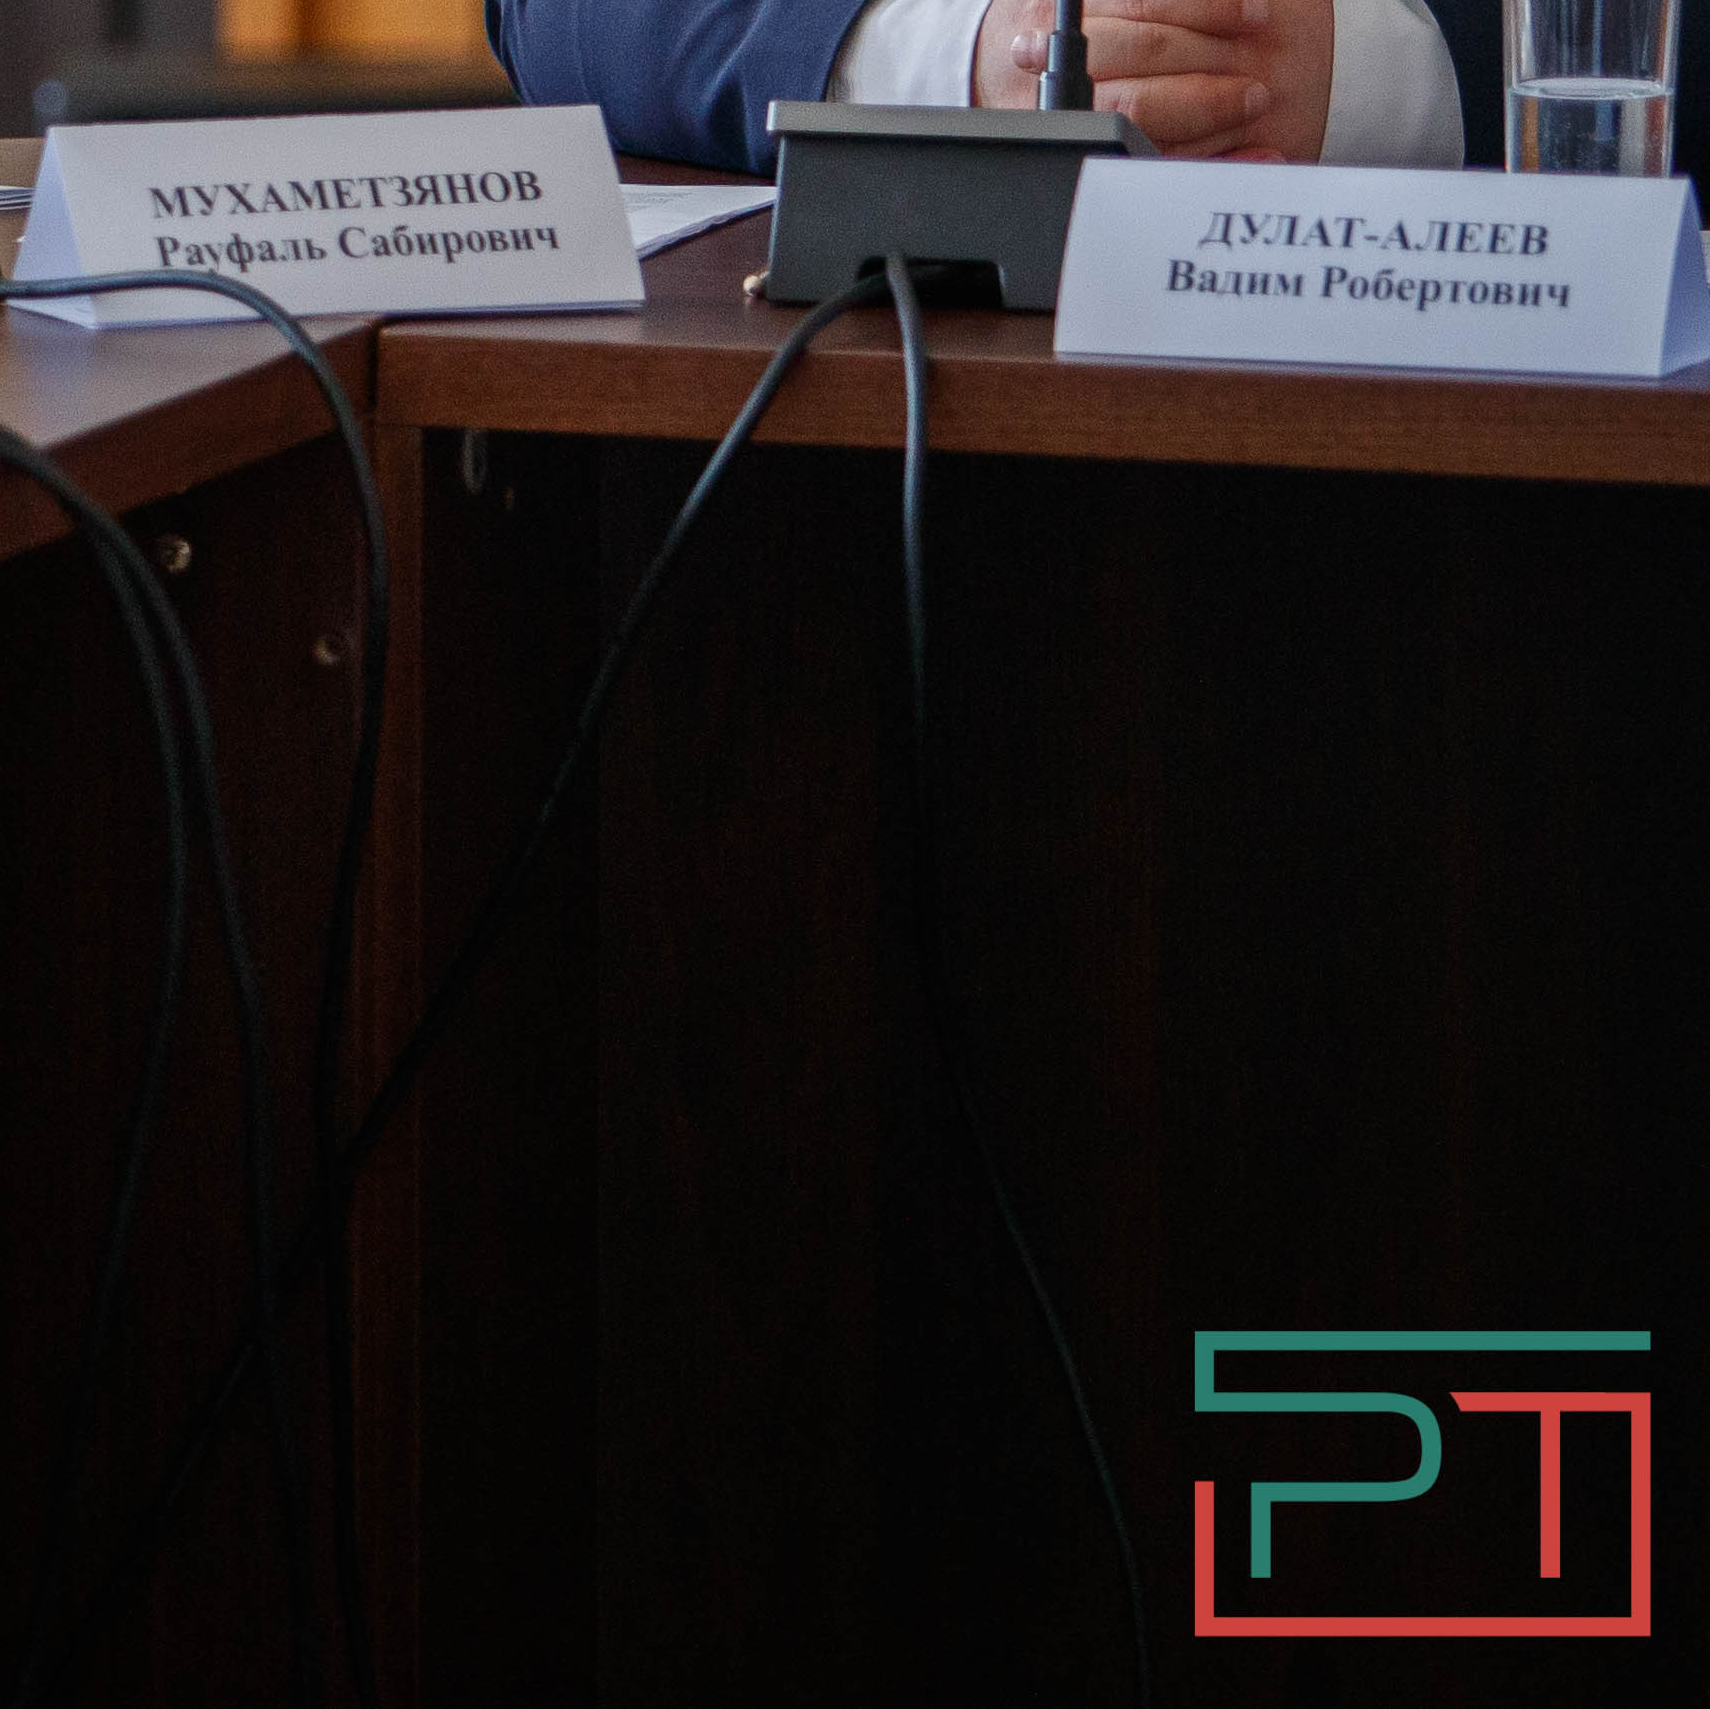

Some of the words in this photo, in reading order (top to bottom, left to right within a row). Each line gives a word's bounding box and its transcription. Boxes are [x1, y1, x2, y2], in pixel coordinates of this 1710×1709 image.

[150, 170, 544, 220] МУХАМЕТЗЯНОВ
[157, 226, 327, 274] Рауфаль
[337, 222, 561, 264] Сабирович
[1196, 211, 1551, 257] ДУЛАТ-АЛЕЕВ
[1166, 258, 1306, 299] Вадим
[1321, 264, 1572, 312] Робертович
